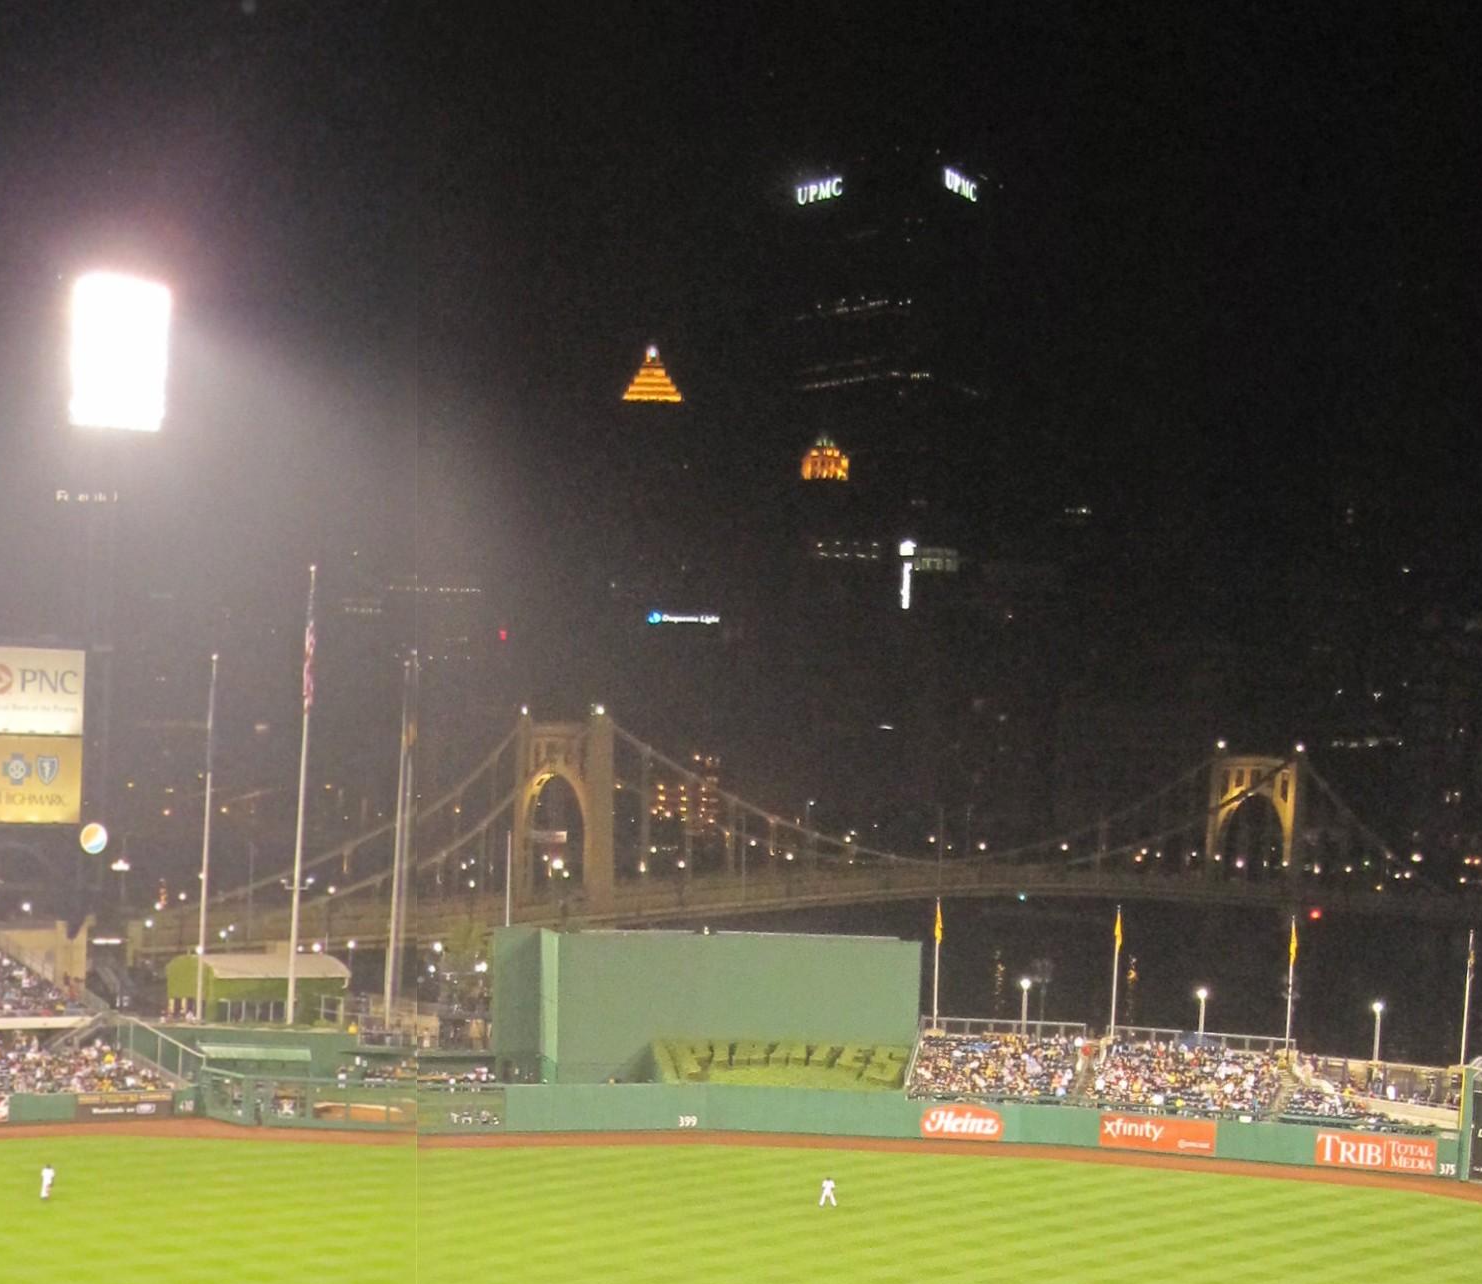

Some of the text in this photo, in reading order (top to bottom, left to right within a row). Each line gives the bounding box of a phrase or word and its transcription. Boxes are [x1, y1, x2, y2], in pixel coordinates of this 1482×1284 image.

[797, 178, 843, 205] UPMC
[944, 168, 978, 202] UPMC
[18, 668, 78, 695] PNC
[678, 1115, 697, 1127] 399
[925, 1104, 998, 1135] Heinz
[1104, 1118, 1164, 1142] xfinity
[1317, 1133, 1383, 1166] TRIB
[1388, 1140, 1433, 1157] TOTAL
[1390, 1156, 1434, 1171] MEDIA
[1440, 1163, 1456, 1175] 375
